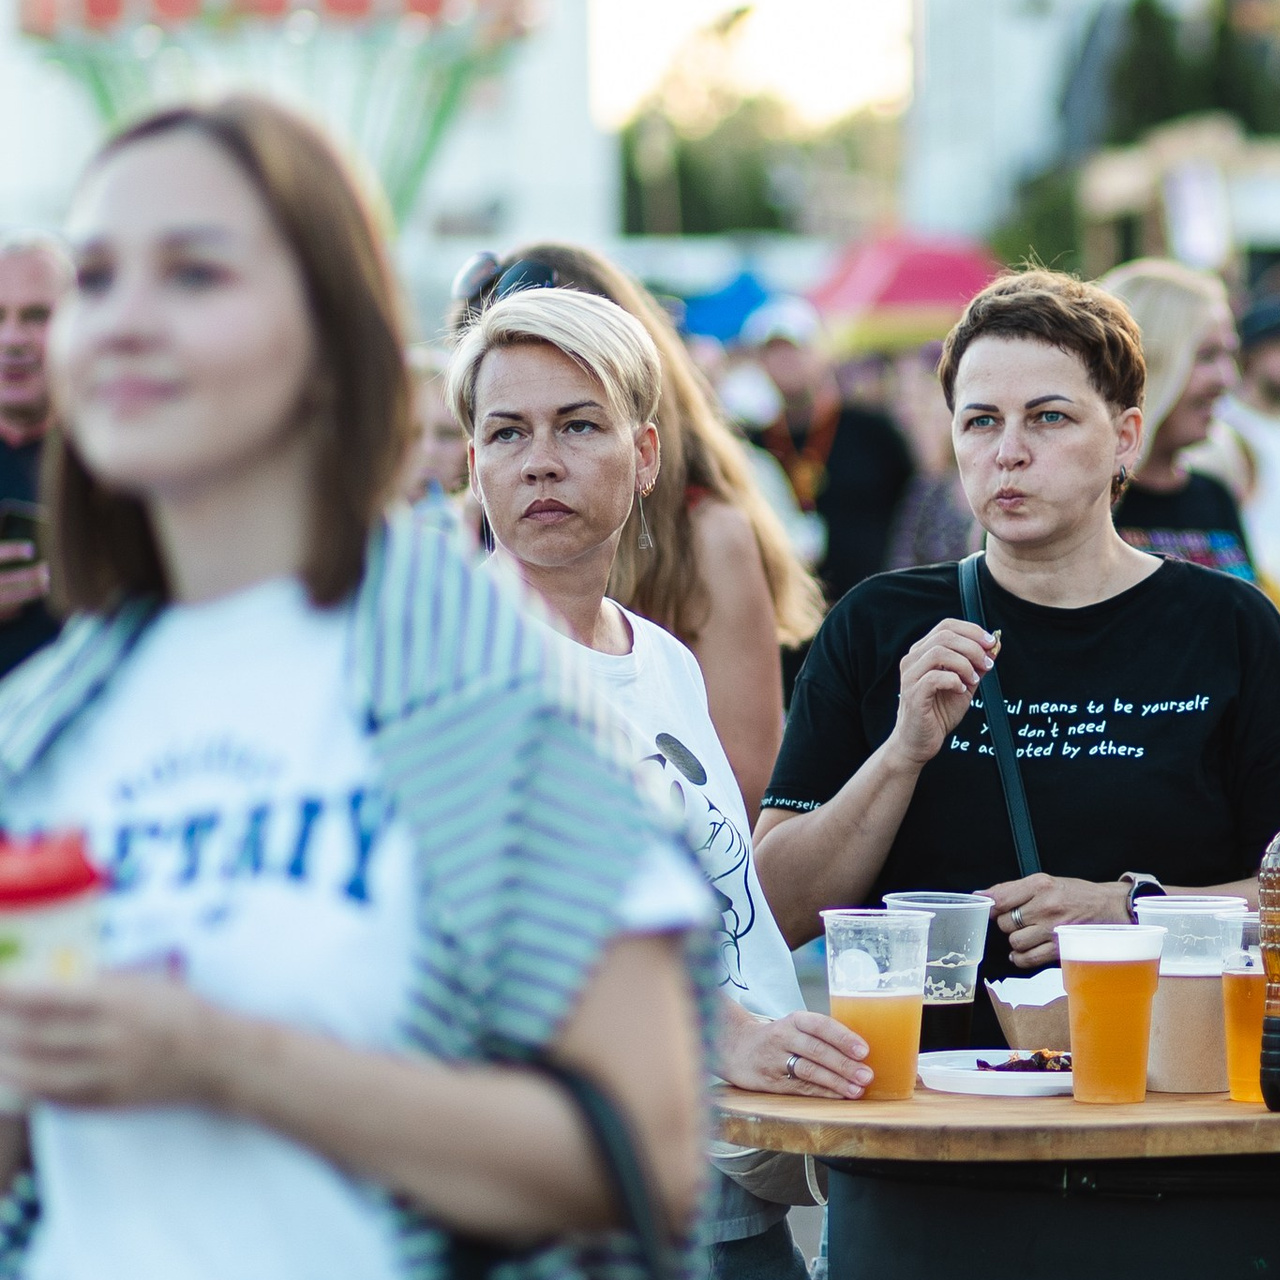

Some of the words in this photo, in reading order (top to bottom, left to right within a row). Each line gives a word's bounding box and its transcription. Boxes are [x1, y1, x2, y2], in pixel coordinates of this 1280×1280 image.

[1028, 701, 1078, 715] means
[1086, 700, 1104, 714] to
[1113, 698, 1133, 713] be
[1141, 694, 1210, 716] yourself
[1017, 716, 1059, 738] don't
[1067, 720, 1107, 735] need
[950, 735, 970, 751] be
[978, 741, 1054, 758] acpted
[1061, 741, 1082, 759] by
[1088, 740, 1144, 758] others
[775, 798, 821, 810] yourself
